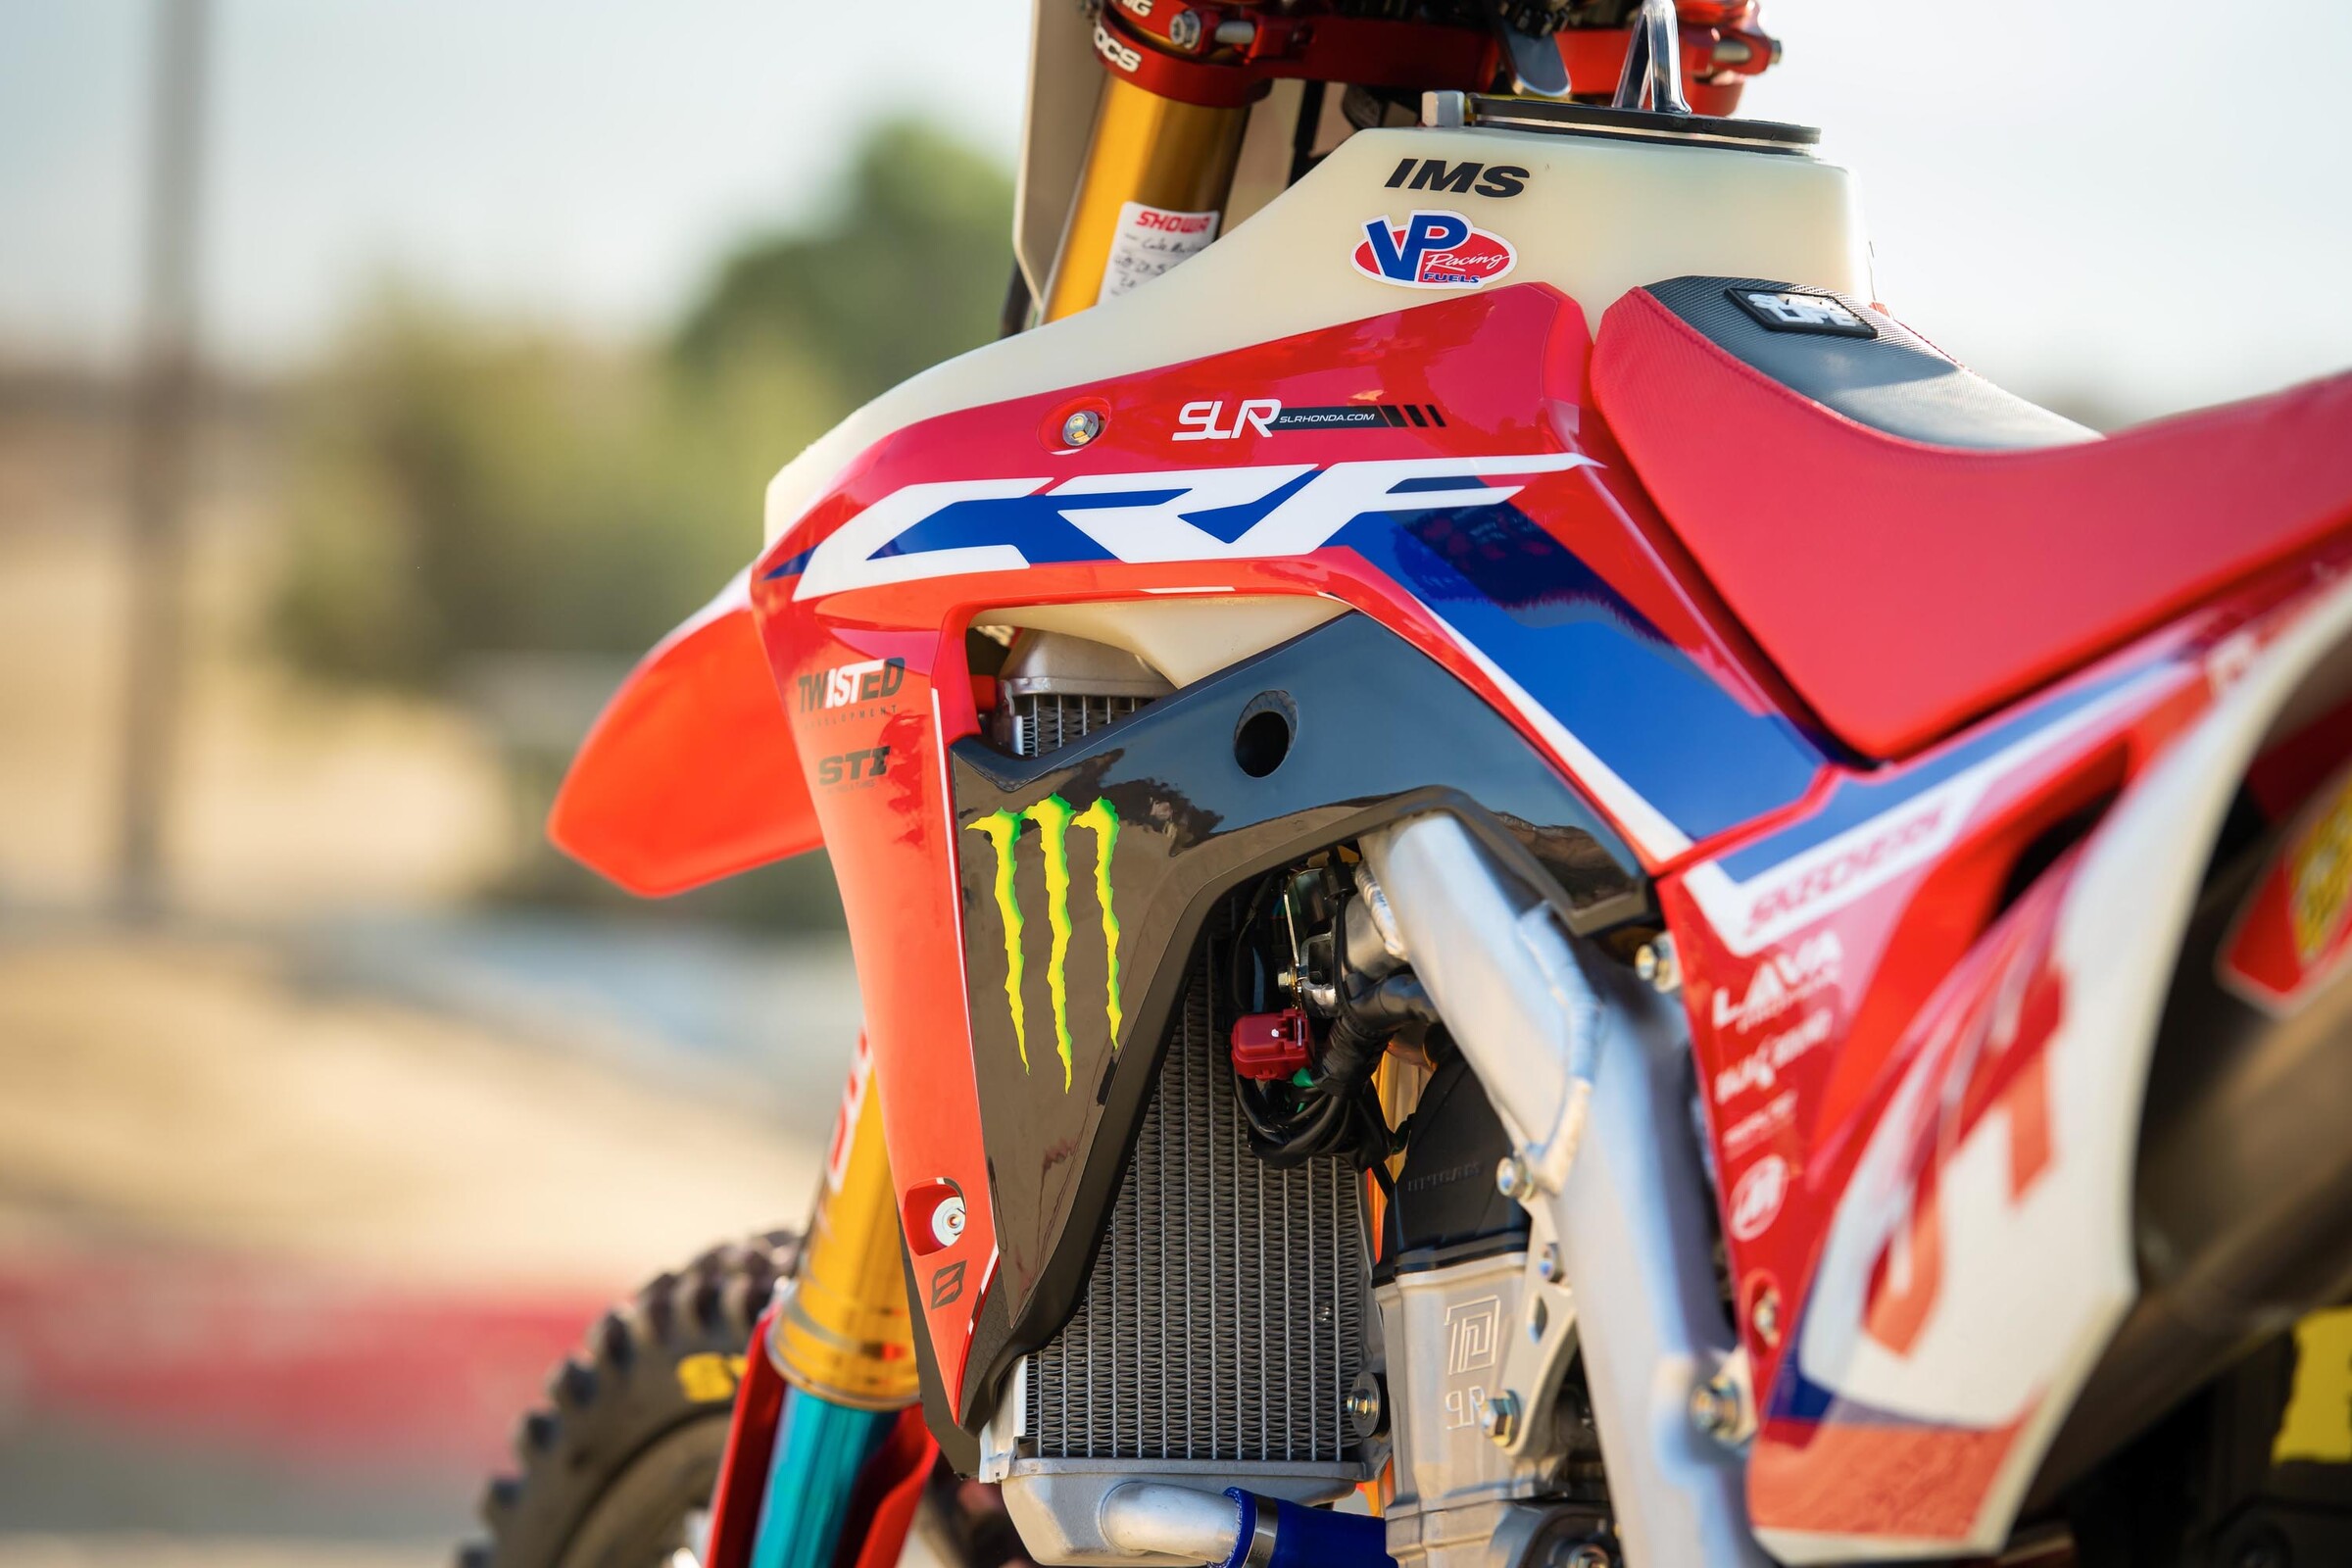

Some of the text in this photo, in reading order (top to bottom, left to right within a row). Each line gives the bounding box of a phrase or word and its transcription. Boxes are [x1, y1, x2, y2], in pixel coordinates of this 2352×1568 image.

[1384, 158, 1531, 198] IMS
[1365, 214, 1469, 282] VP
[1424, 251, 1510, 272] Racing
[1423, 271, 1481, 284] FUELS
[1172, 398, 1375, 441] SLR SLRHONDA.COM
[793, 453, 1607, 602] CRF
[798, 657, 906, 713] TWISTED
[817, 745, 892, 786] STI
